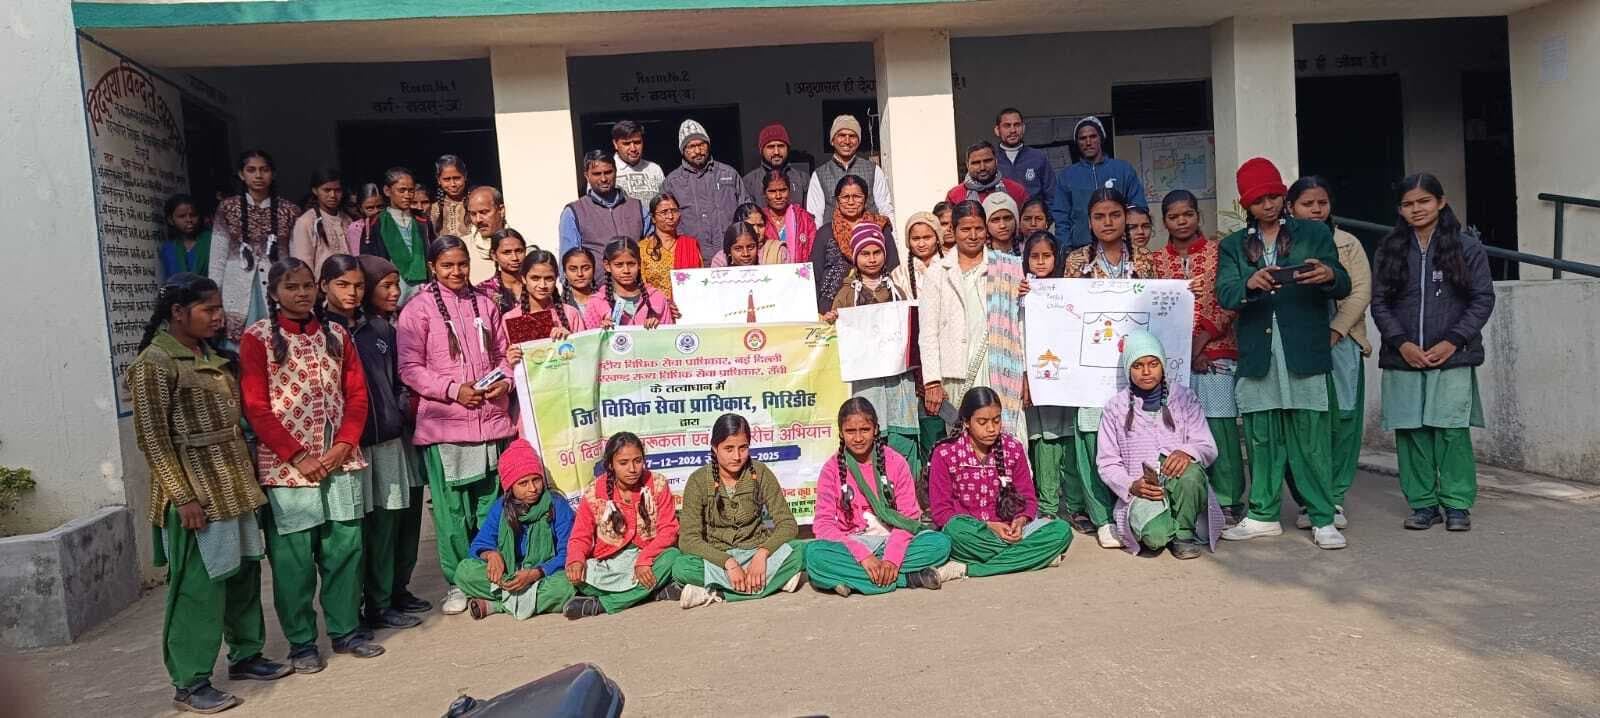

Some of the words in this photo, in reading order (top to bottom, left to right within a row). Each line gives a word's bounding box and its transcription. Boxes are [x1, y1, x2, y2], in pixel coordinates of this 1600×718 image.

[662, 358, 682, 367] सेवा
[632, 372, 656, 380] राज्य
[659, 370, 692, 379] विधिक
[696, 368, 716, 377] सेवा
[650, 384, 661, 393] के
[715, 381, 726, 391] में
[602, 398, 651, 417] विधिक
[655, 395, 686, 413] सेवा
[690, 394, 757, 413] प्राधिकार,
[762, 389, 817, 409] गिरिडीह
[680, 418, 700, 427] द्वारा
[560, 450, 575, 466] 90
[692, 428, 711, 447] एवं
[779, 423, 832, 441] अभियान
